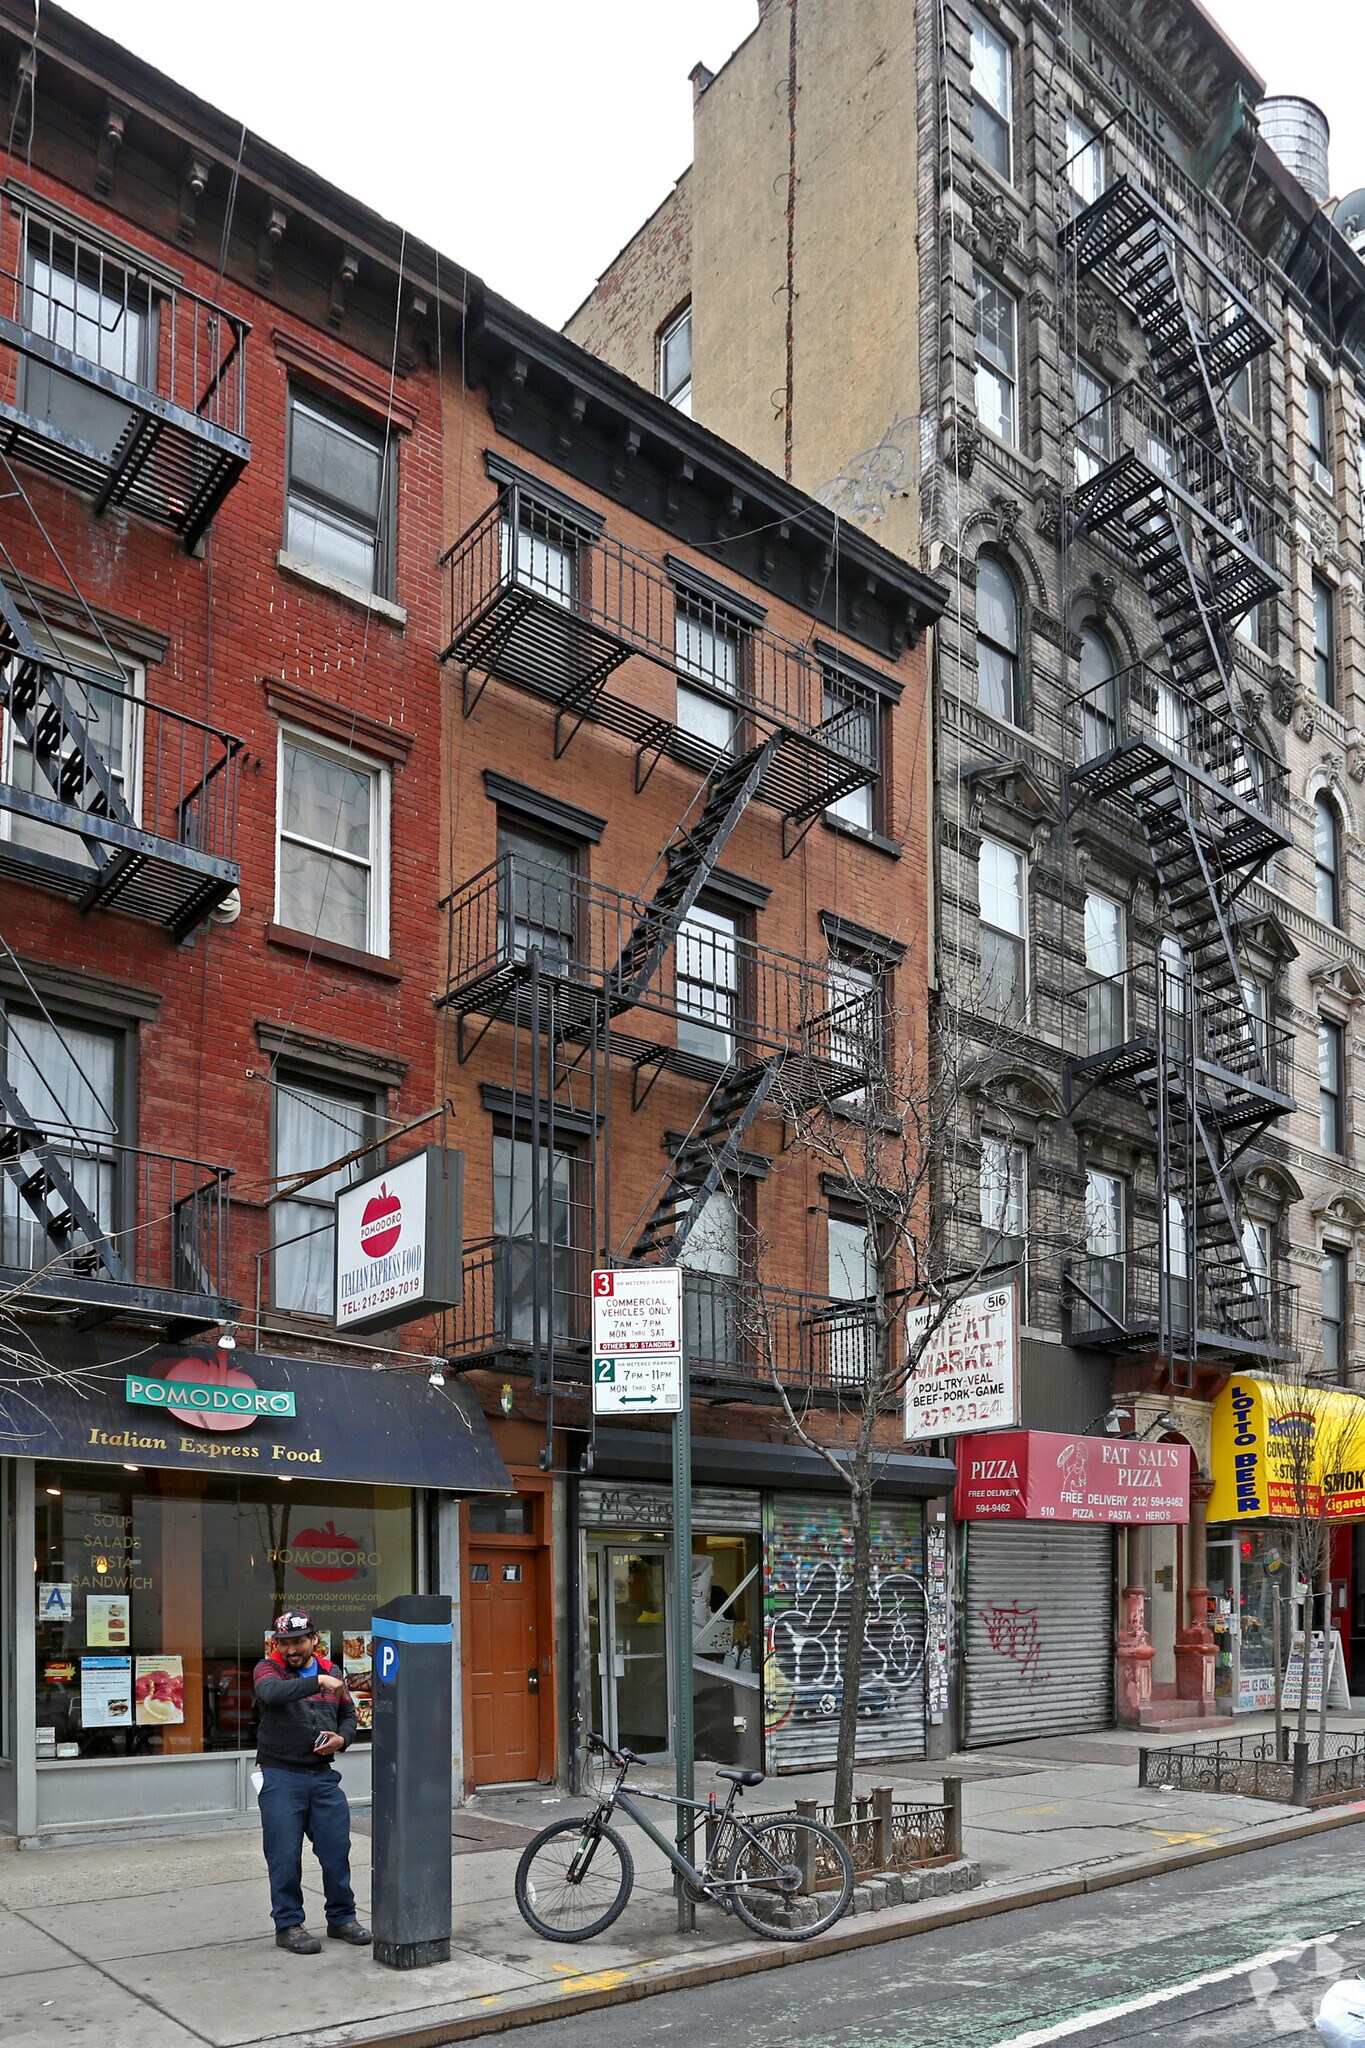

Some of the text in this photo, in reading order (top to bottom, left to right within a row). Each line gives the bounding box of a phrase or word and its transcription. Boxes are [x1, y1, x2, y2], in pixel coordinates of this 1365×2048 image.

[361, 1213, 401, 1239] POMODORO
[341, 1244, 422, 1299] ITALIAN EXPRESS FOOD
[597, 1274, 610, 1295] 3
[343, 1277, 420, 1316] TEL: 212-239-7019
[606, 1298, 667, 1308] COMMERCIAL
[987, 1294, 1006, 1309] 516
[602, 1306, 672, 1317] VEHICLES ONLY
[609, 1330, 627, 1338] MON
[650, 1329, 665, 1337] SAT
[598, 1360, 611, 1381] 2
[610, 1385, 627, 1393] MON
[651, 1383, 666, 1392] SAT
[131, 1381, 291, 1413] POMODORO
[1232, 1387, 1257, 1446] LOTTO
[88, 1428, 323, 1464] Italian Express Food
[1102, 1445, 1179, 1468] FAT SAL'S
[971, 1459, 1019, 1480] PIZZA
[1117, 1468, 1162, 1487] PIZZA
[1234, 1453, 1261, 1513] BEER
[968, 1488, 1020, 1498] FREE DELIVERY
[1060, 1491, 1083, 1504] FREE
[1088, 1493, 1128, 1507] DELIVERY
[1150, 1497, 1184, 1507] 594-9462
[976, 1504, 1011, 1513] 594-9462
[1040, 1506, 1055, 1516] 510
[1072, 1508, 1094, 1519] PIZZA
[1108, 1510, 1132, 1520] PASTA
[93, 1515, 133, 1528] SOUP
[83, 1534, 141, 1549] SALADS
[90, 1555, 133, 1569] PASTA
[267, 1549, 381, 1566] POMODORO
[45, 1588, 66, 1610] A
[269, 1592, 382, 1603] www.pomodoronyc.com
[383, 1646, 394, 1677] P
